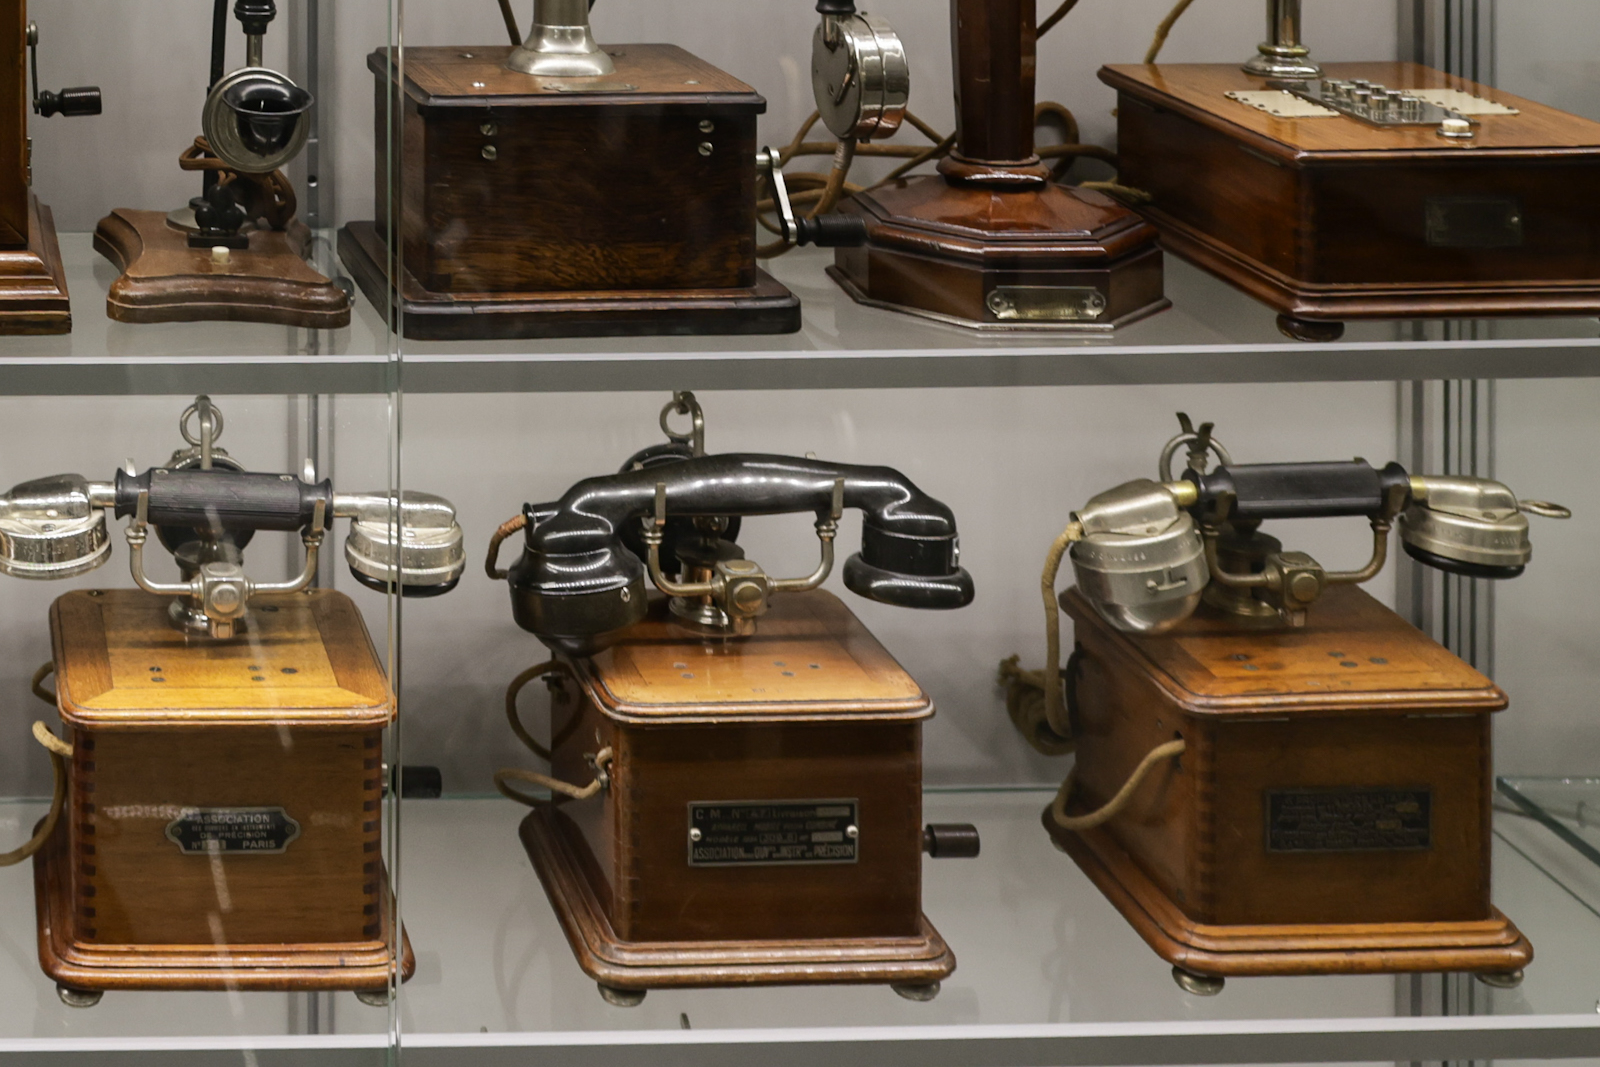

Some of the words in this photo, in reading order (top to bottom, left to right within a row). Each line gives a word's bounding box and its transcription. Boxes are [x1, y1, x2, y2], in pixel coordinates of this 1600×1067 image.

[197, 814, 271, 825] ASSOCIATION
[218, 830, 267, 840] PRÉCISION
[242, 839, 276, 849] PARIS
[693, 845, 745, 861] ASSOCIATION
